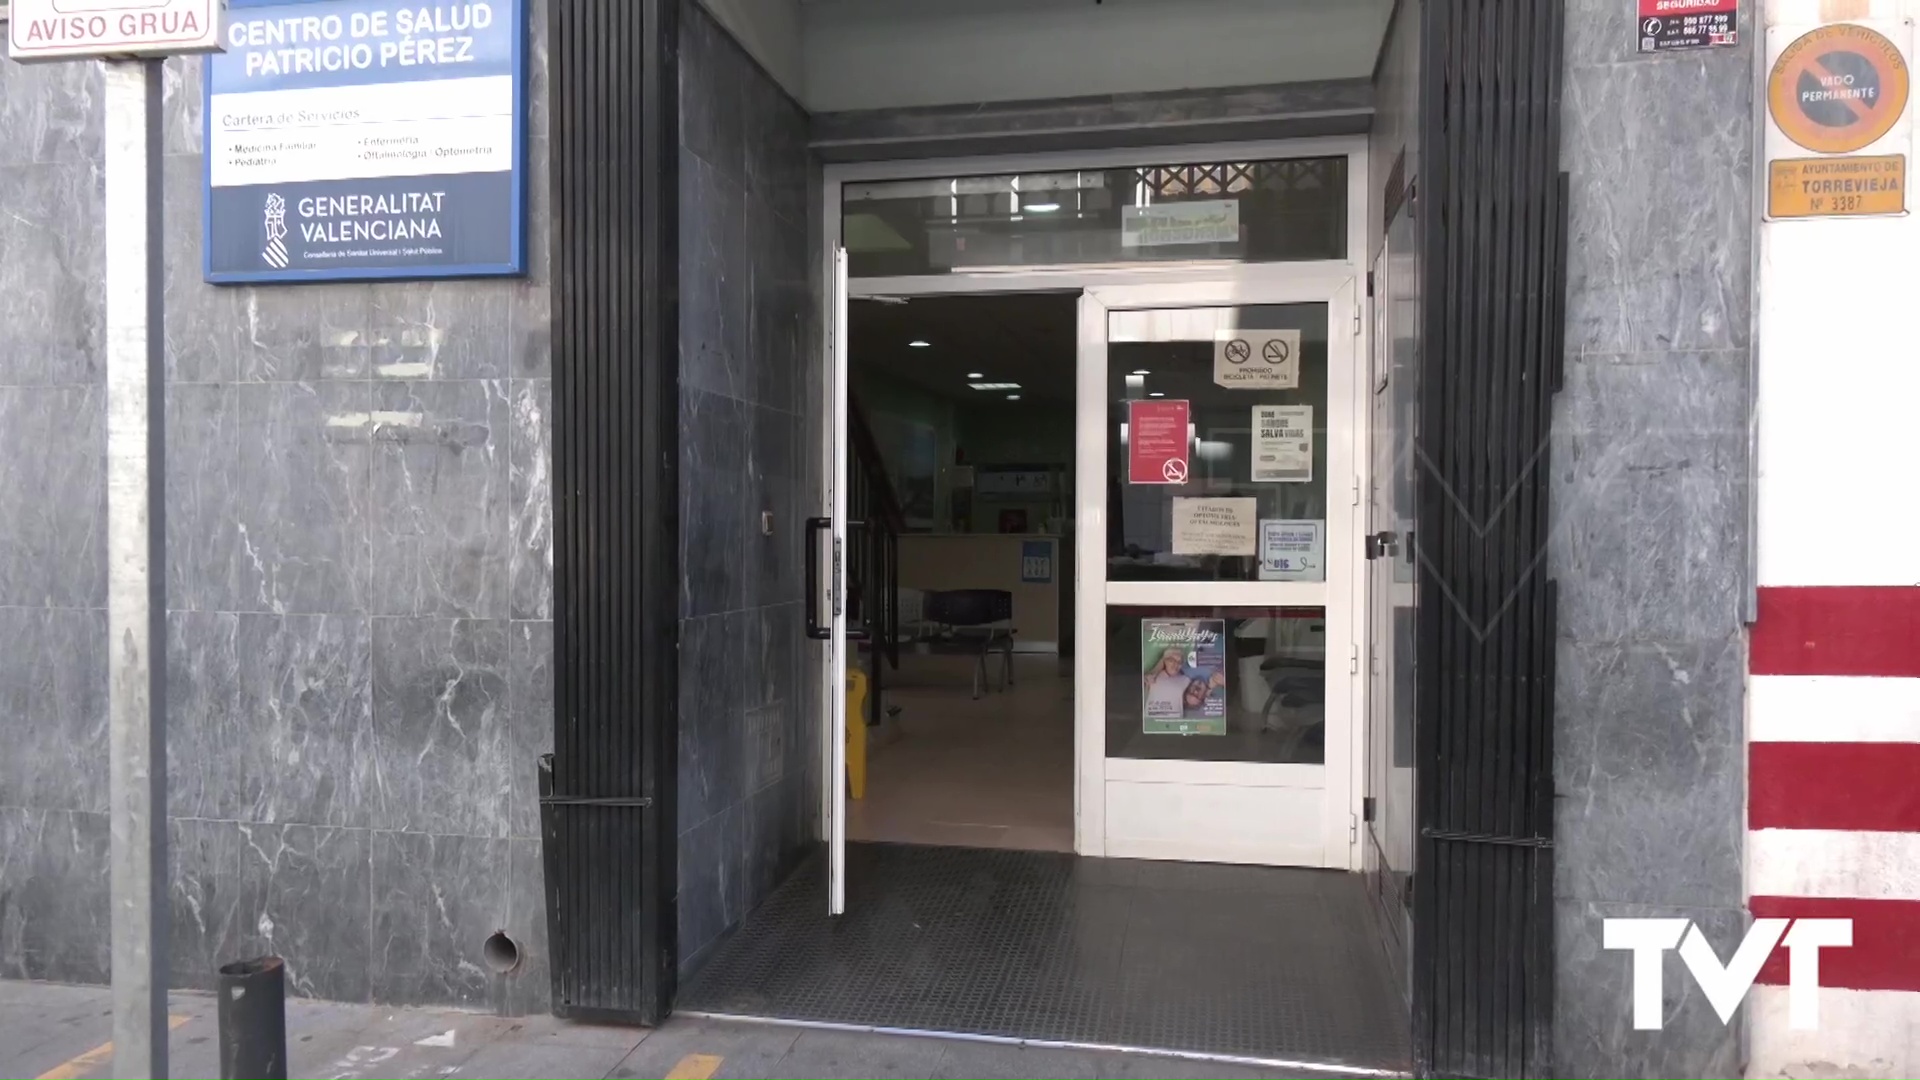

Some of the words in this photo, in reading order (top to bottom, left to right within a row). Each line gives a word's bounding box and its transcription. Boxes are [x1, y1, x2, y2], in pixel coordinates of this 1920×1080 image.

[27, 16, 107, 42] AVISO
[119, 11, 199, 36] GRUA
[228, 15, 343, 47] CENTRO
[350, 11, 388, 38] DE
[396, 3, 493, 35] SALUD
[246, 43, 373, 77] PATRICIO
[380, 36, 475, 68] PÉREZ
[1776, 37, 1813, 75] SALIDA
[1816, 30, 1834, 41] DE
[1820, 74, 1855, 87] VADO
[1802, 87, 1875, 102] PERMANENTE
[222, 114, 274, 127] Cartera
[277, 112, 294, 124] de
[298, 109, 361, 122] Servicios
[1802, 162, 1881, 175] AYUNTAMIENTO
[1884, 161, 1899, 172] DE
[1802, 177, 1899, 194] TORREVIEJA
[298, 192, 446, 218] GENERALITAT
[1831, 195, 1862, 211] 3387
[300, 218, 442, 243] VALENCIANA
[1261, 428, 1284, 438] SALVA
